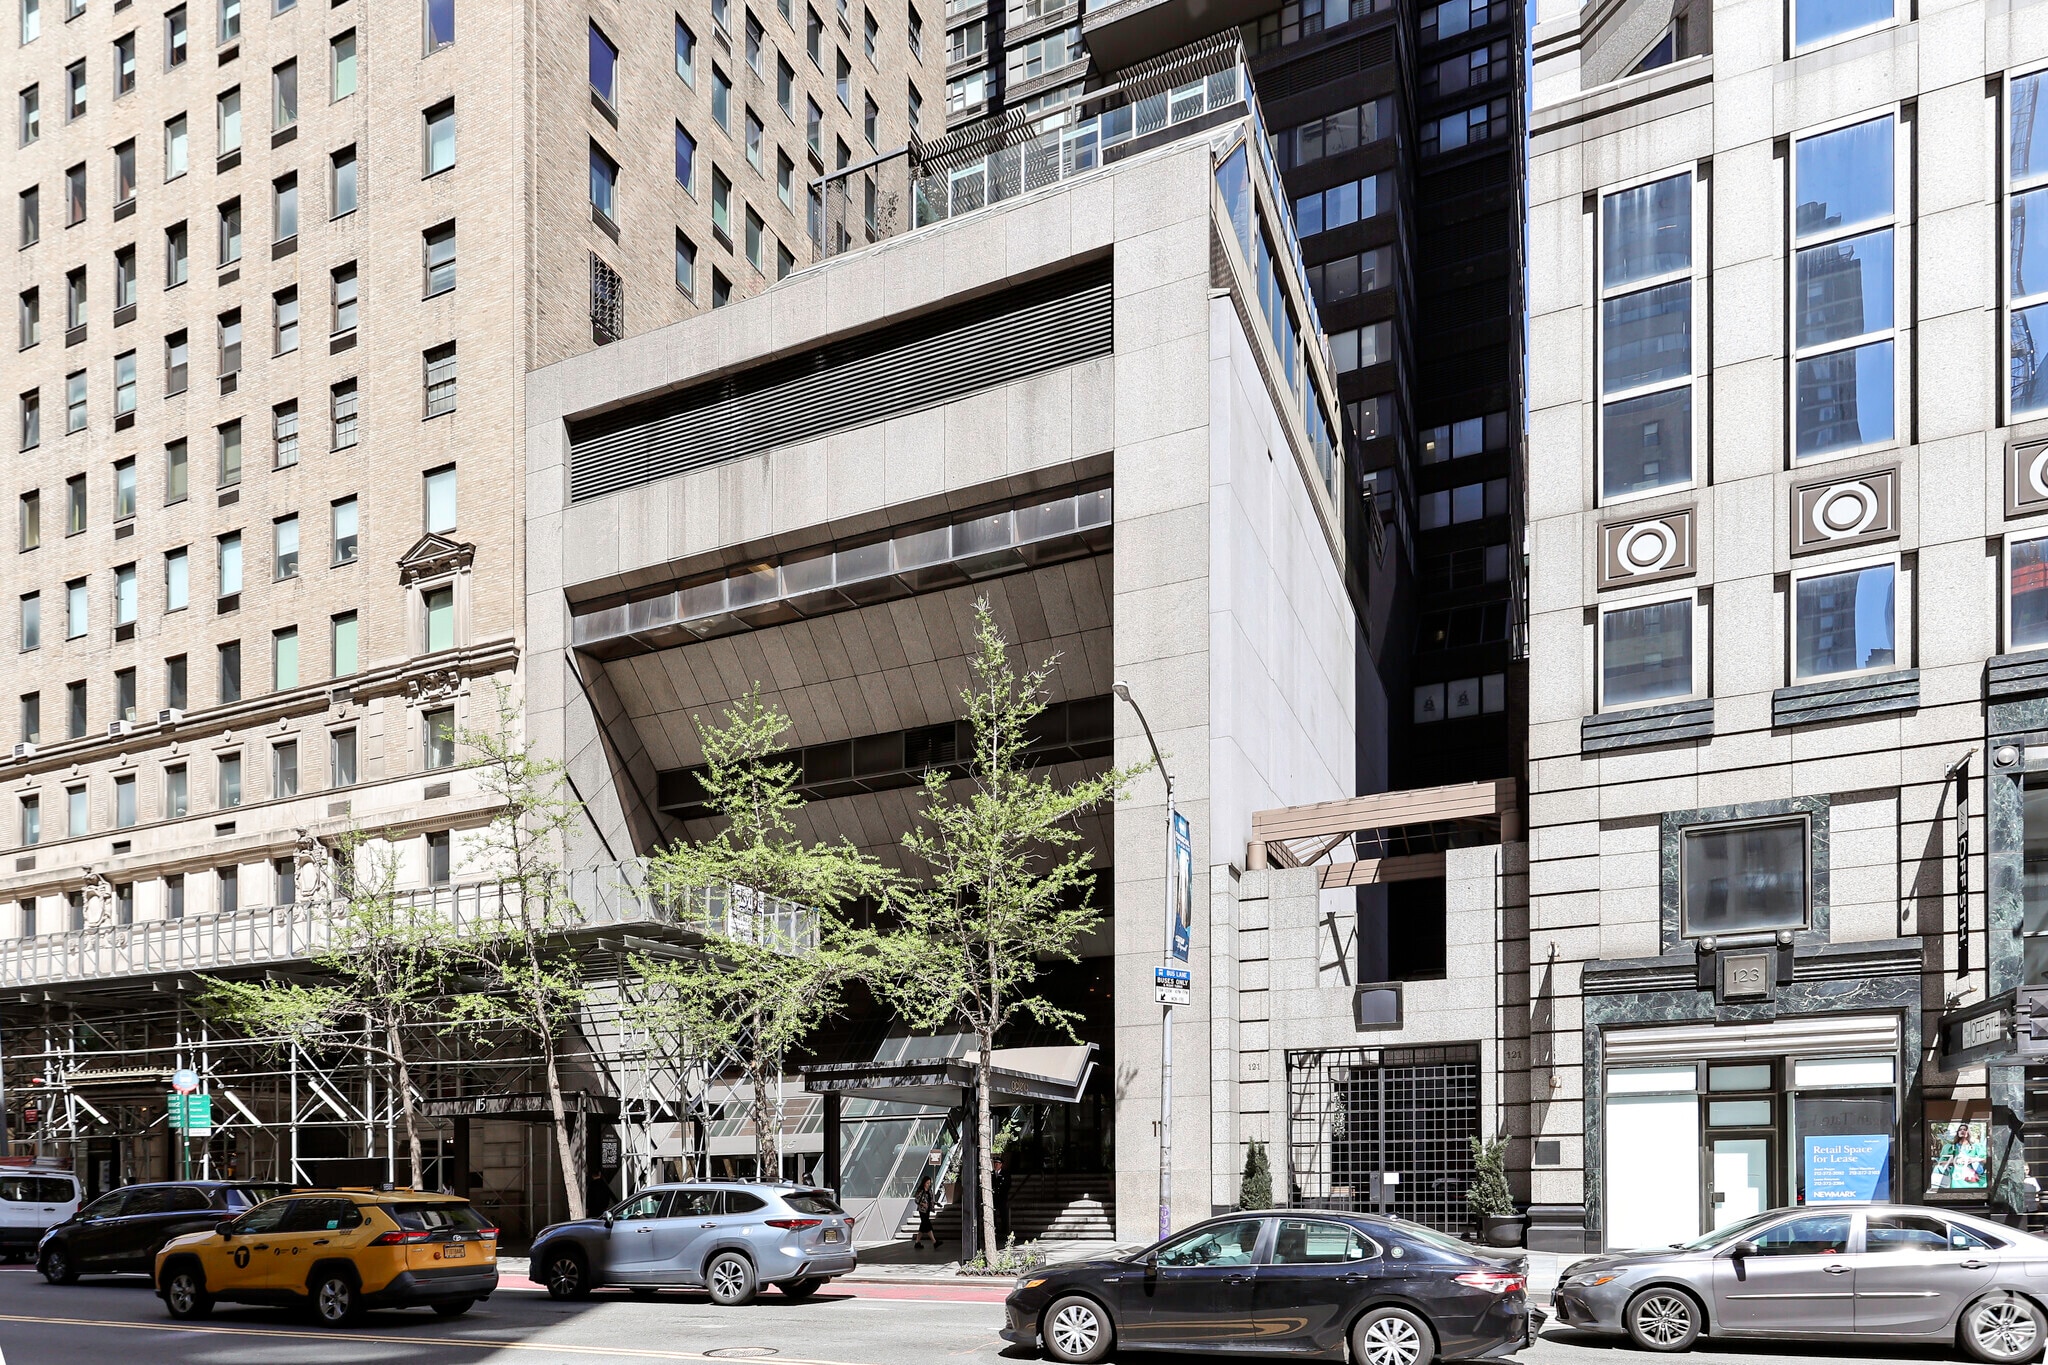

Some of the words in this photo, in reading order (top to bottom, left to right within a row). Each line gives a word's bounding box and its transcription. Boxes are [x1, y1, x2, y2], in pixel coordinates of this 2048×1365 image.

[1959, 838, 1967, 888] OFF
[1733, 968, 1760, 983] 123
[1157, 977, 1174, 985] BUSES
[1506, 1050, 1521, 1059] 121
[1247, 1063, 1261, 1071] 121
[1813, 1145, 1841, 1154] Retail
[1843, 1145, 1873, 1156] Space
[1813, 1154, 1828, 1163] for
[1830, 1154, 1858, 1163] Lease
[1813, 1190, 1857, 1198] NEWMARK
